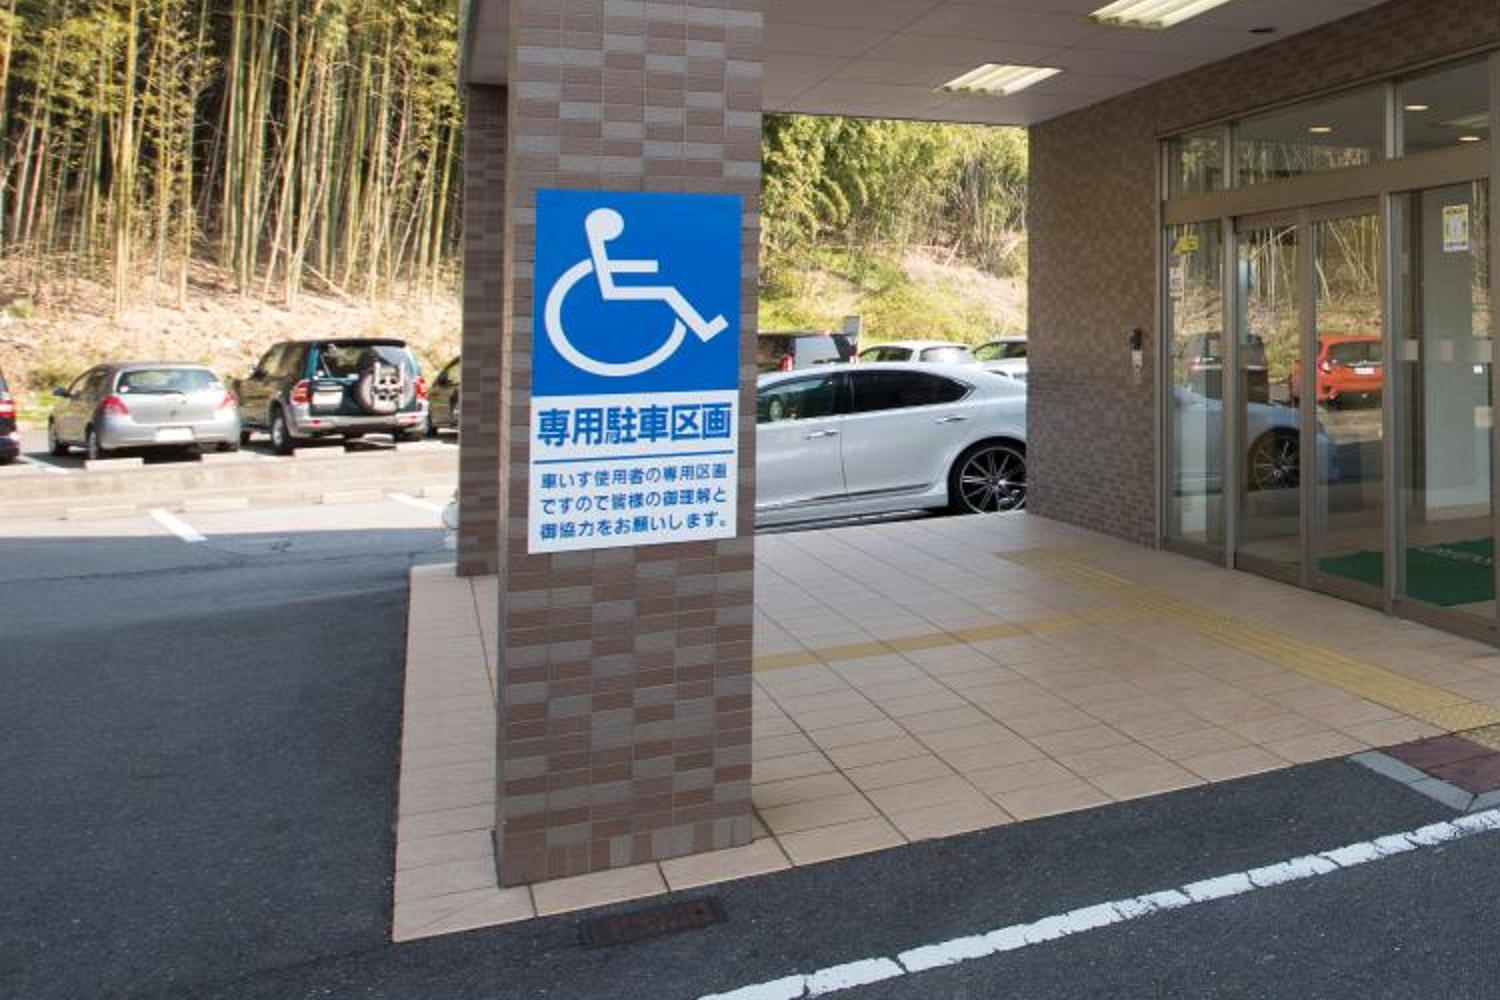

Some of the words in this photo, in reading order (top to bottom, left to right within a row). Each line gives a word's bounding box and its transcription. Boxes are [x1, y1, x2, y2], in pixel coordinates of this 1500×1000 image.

[537, 402, 732, 446] 専用駐車区画
[541, 464, 727, 488] 車いす使用者の専用区画
[540, 487, 727, 514] ですので皆様の御理解と
